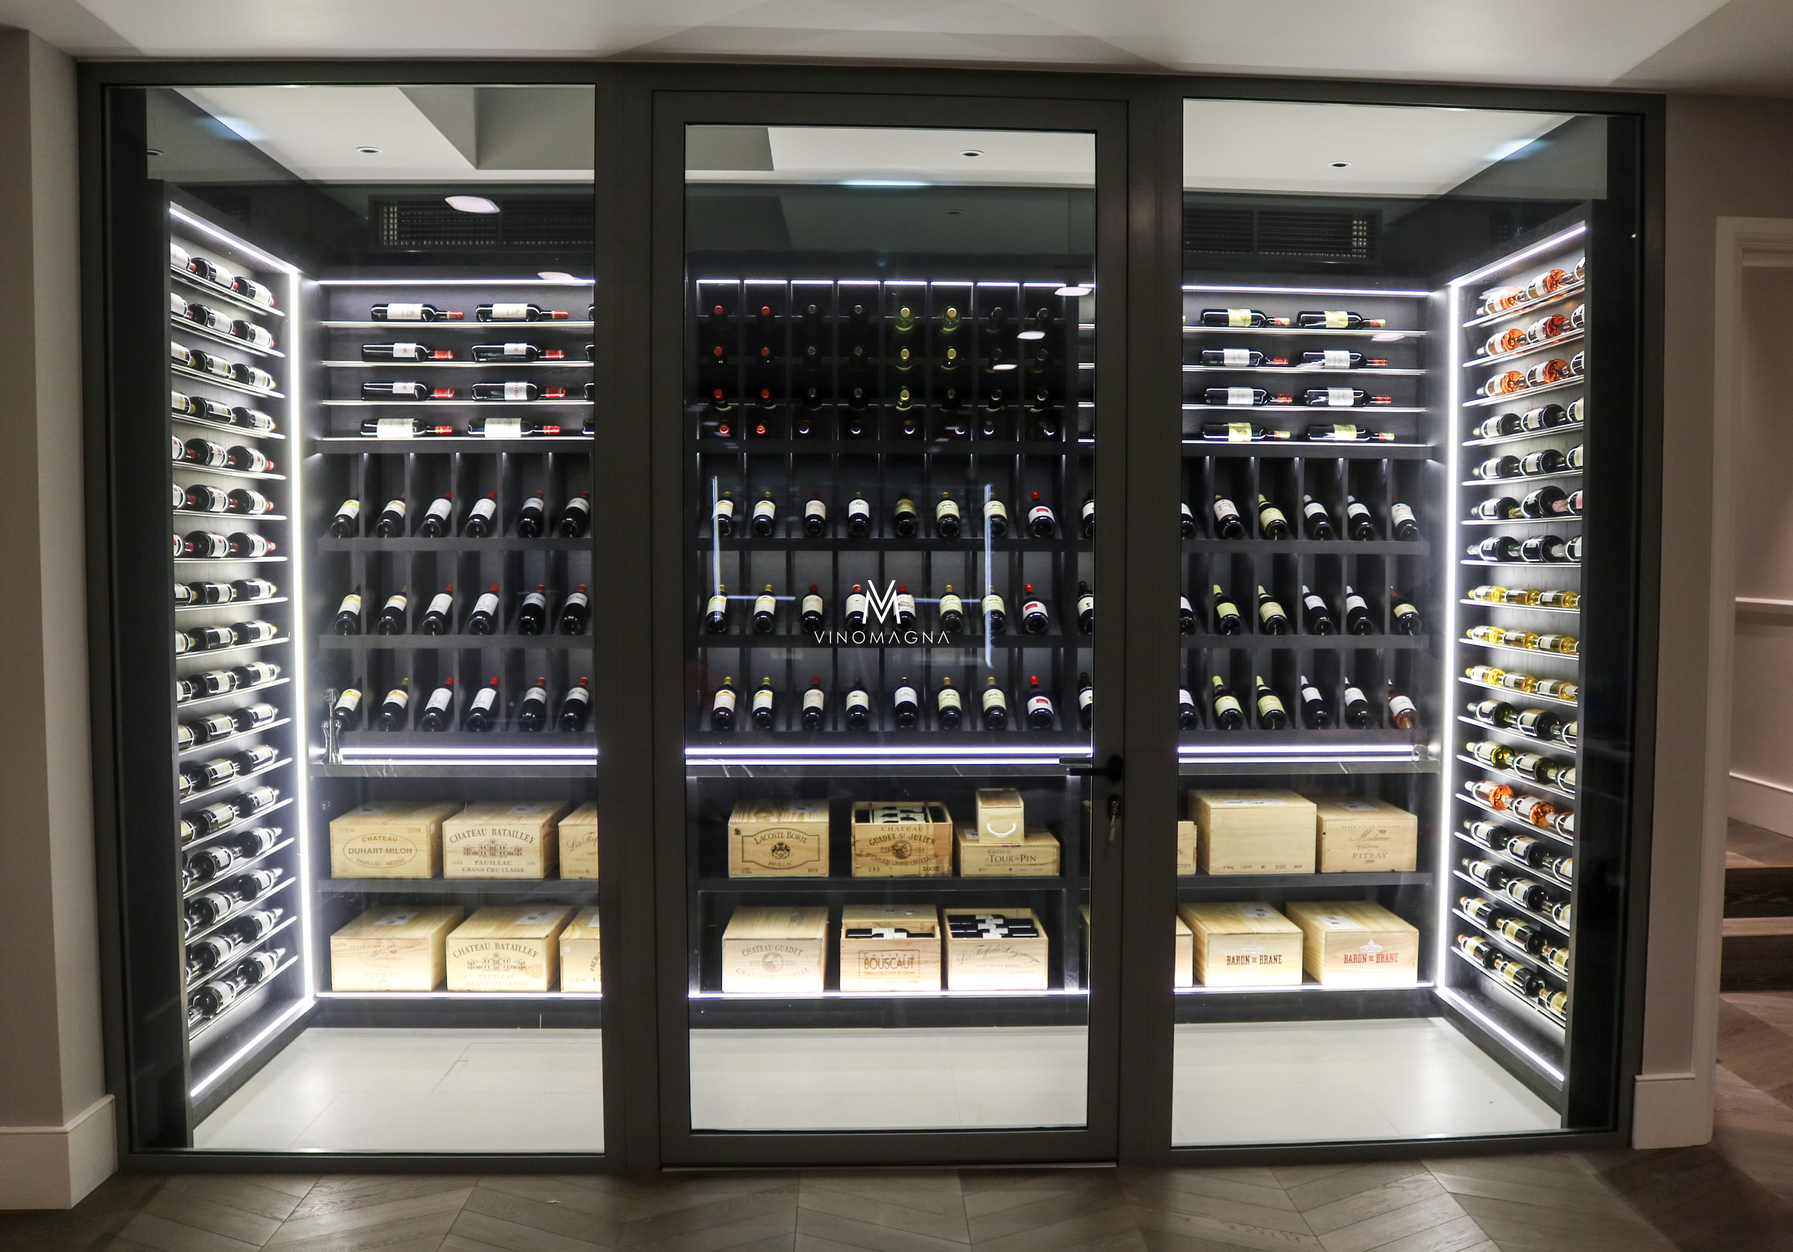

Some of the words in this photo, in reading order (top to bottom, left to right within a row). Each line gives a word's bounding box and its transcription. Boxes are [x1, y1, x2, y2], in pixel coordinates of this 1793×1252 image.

[361, 835, 398, 843] CHATEAU
[449, 828, 487, 844] CHATEAU
[491, 828, 536, 844] BATAILLEY
[868, 833, 896, 846] GUADET
[452, 943, 490, 958] CHATEAU
[494, 942, 539, 958] BATAILLEY
[741, 944, 774, 957] CHATEAU
[774, 944, 804, 957] GUADET
[864, 957, 915, 970] BOUSCAUT
[1226, 955, 1250, 966] BARON
[1259, 954, 1283, 965] BRANE
[1343, 953, 1367, 964] BARON
[1376, 952, 1399, 963] BRANE
[735, 967, 763, 979] GRAND
